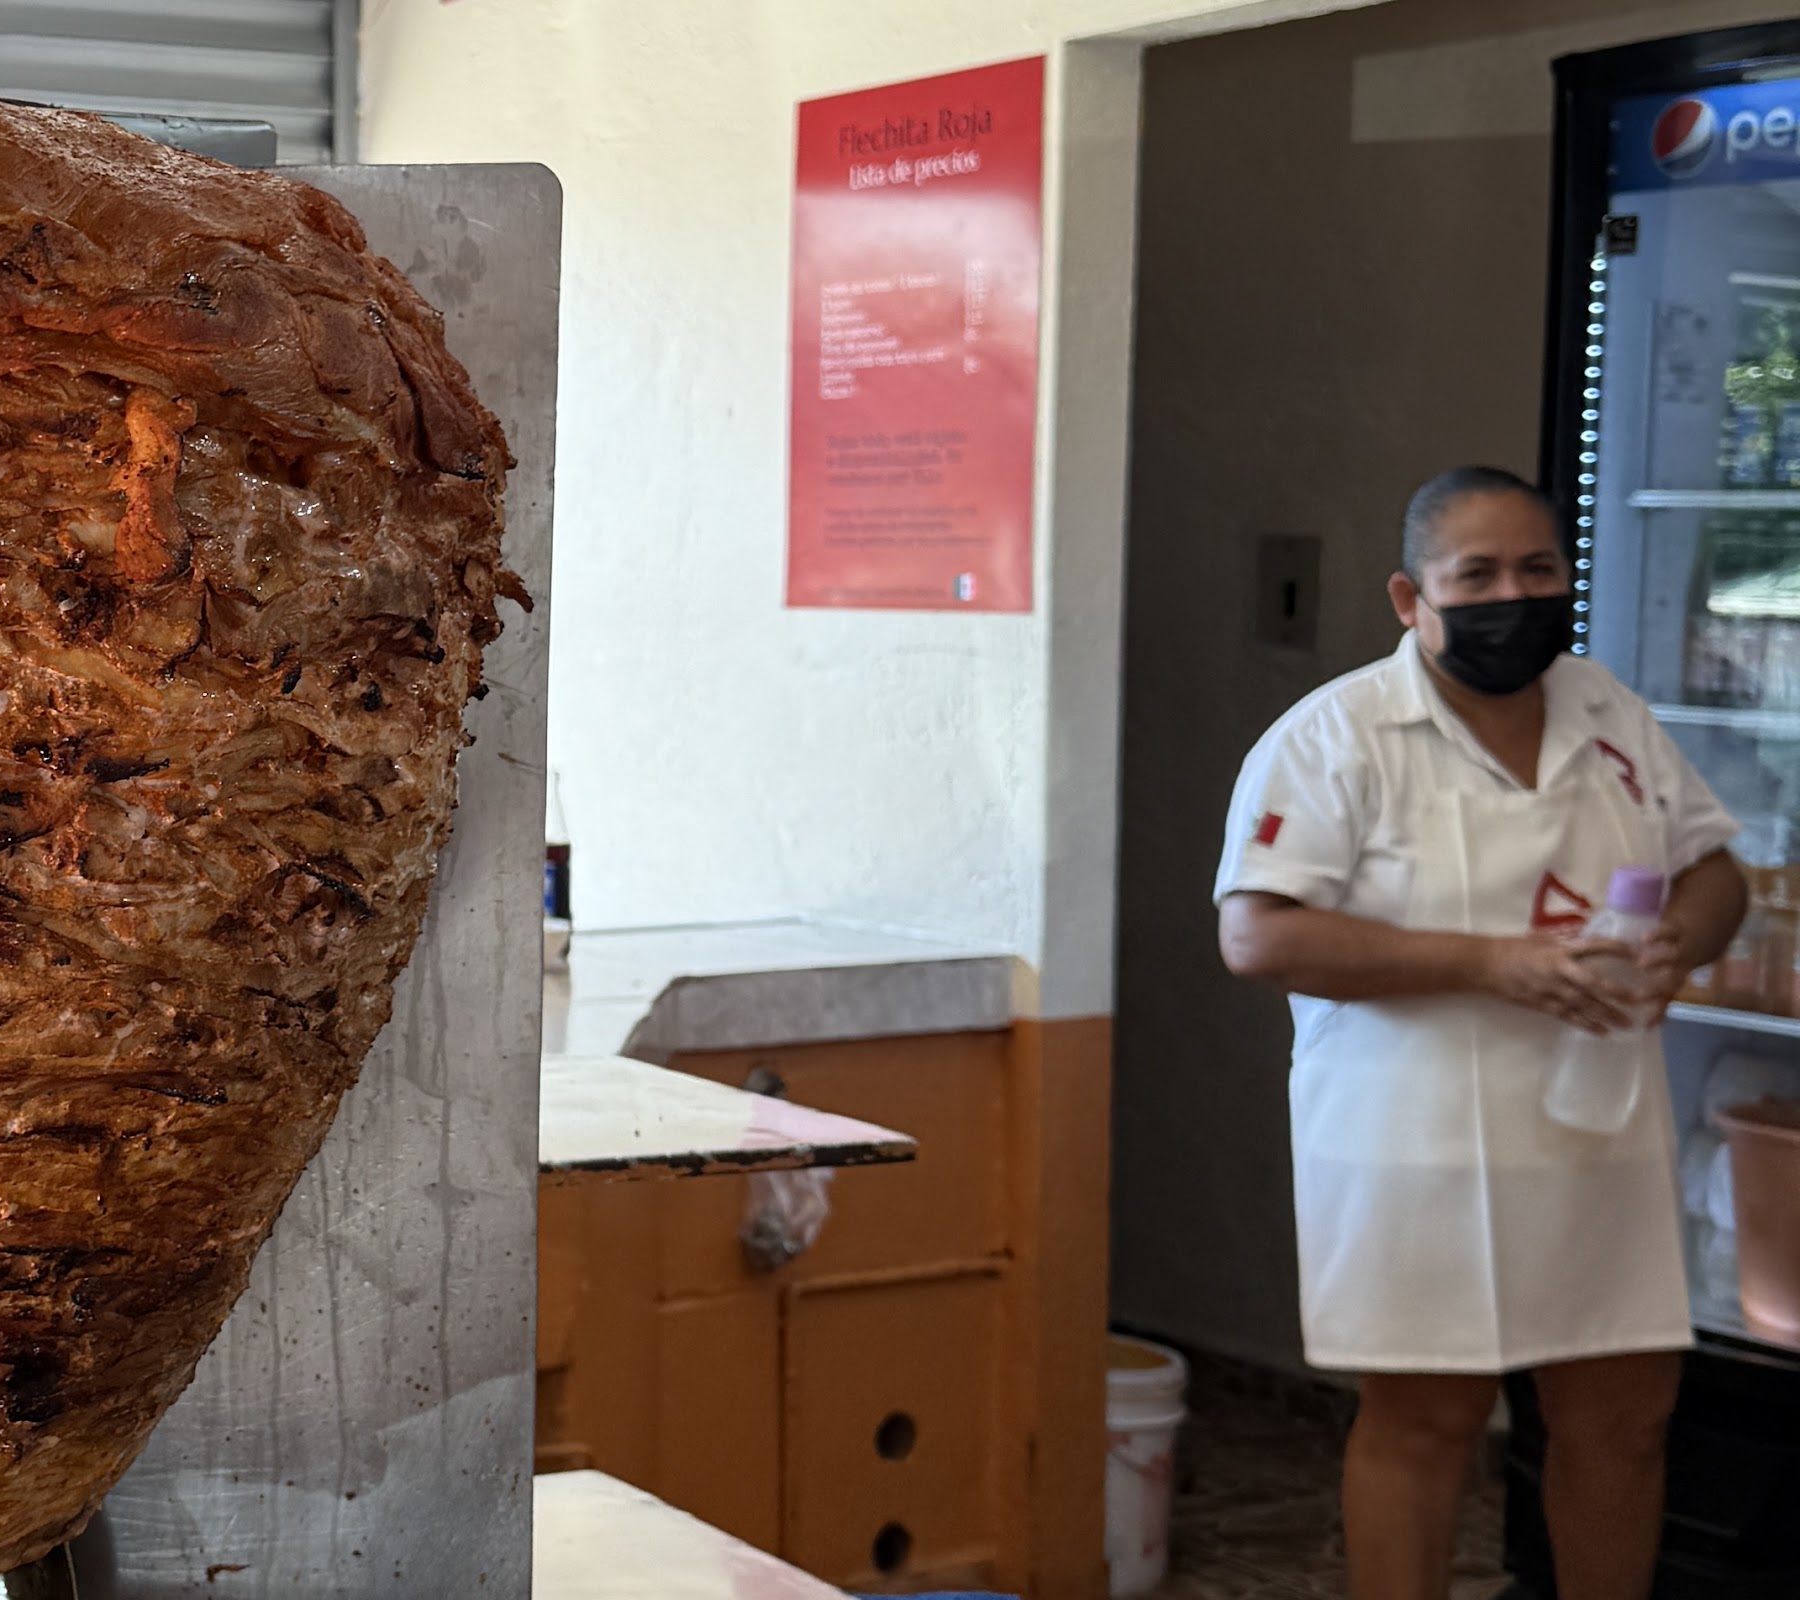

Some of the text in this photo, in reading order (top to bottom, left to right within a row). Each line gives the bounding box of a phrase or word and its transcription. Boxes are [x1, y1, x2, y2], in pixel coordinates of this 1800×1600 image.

[937, 105, 993, 144] Roja
[888, 156, 912, 184] de
[914, 148, 981, 187] precios
